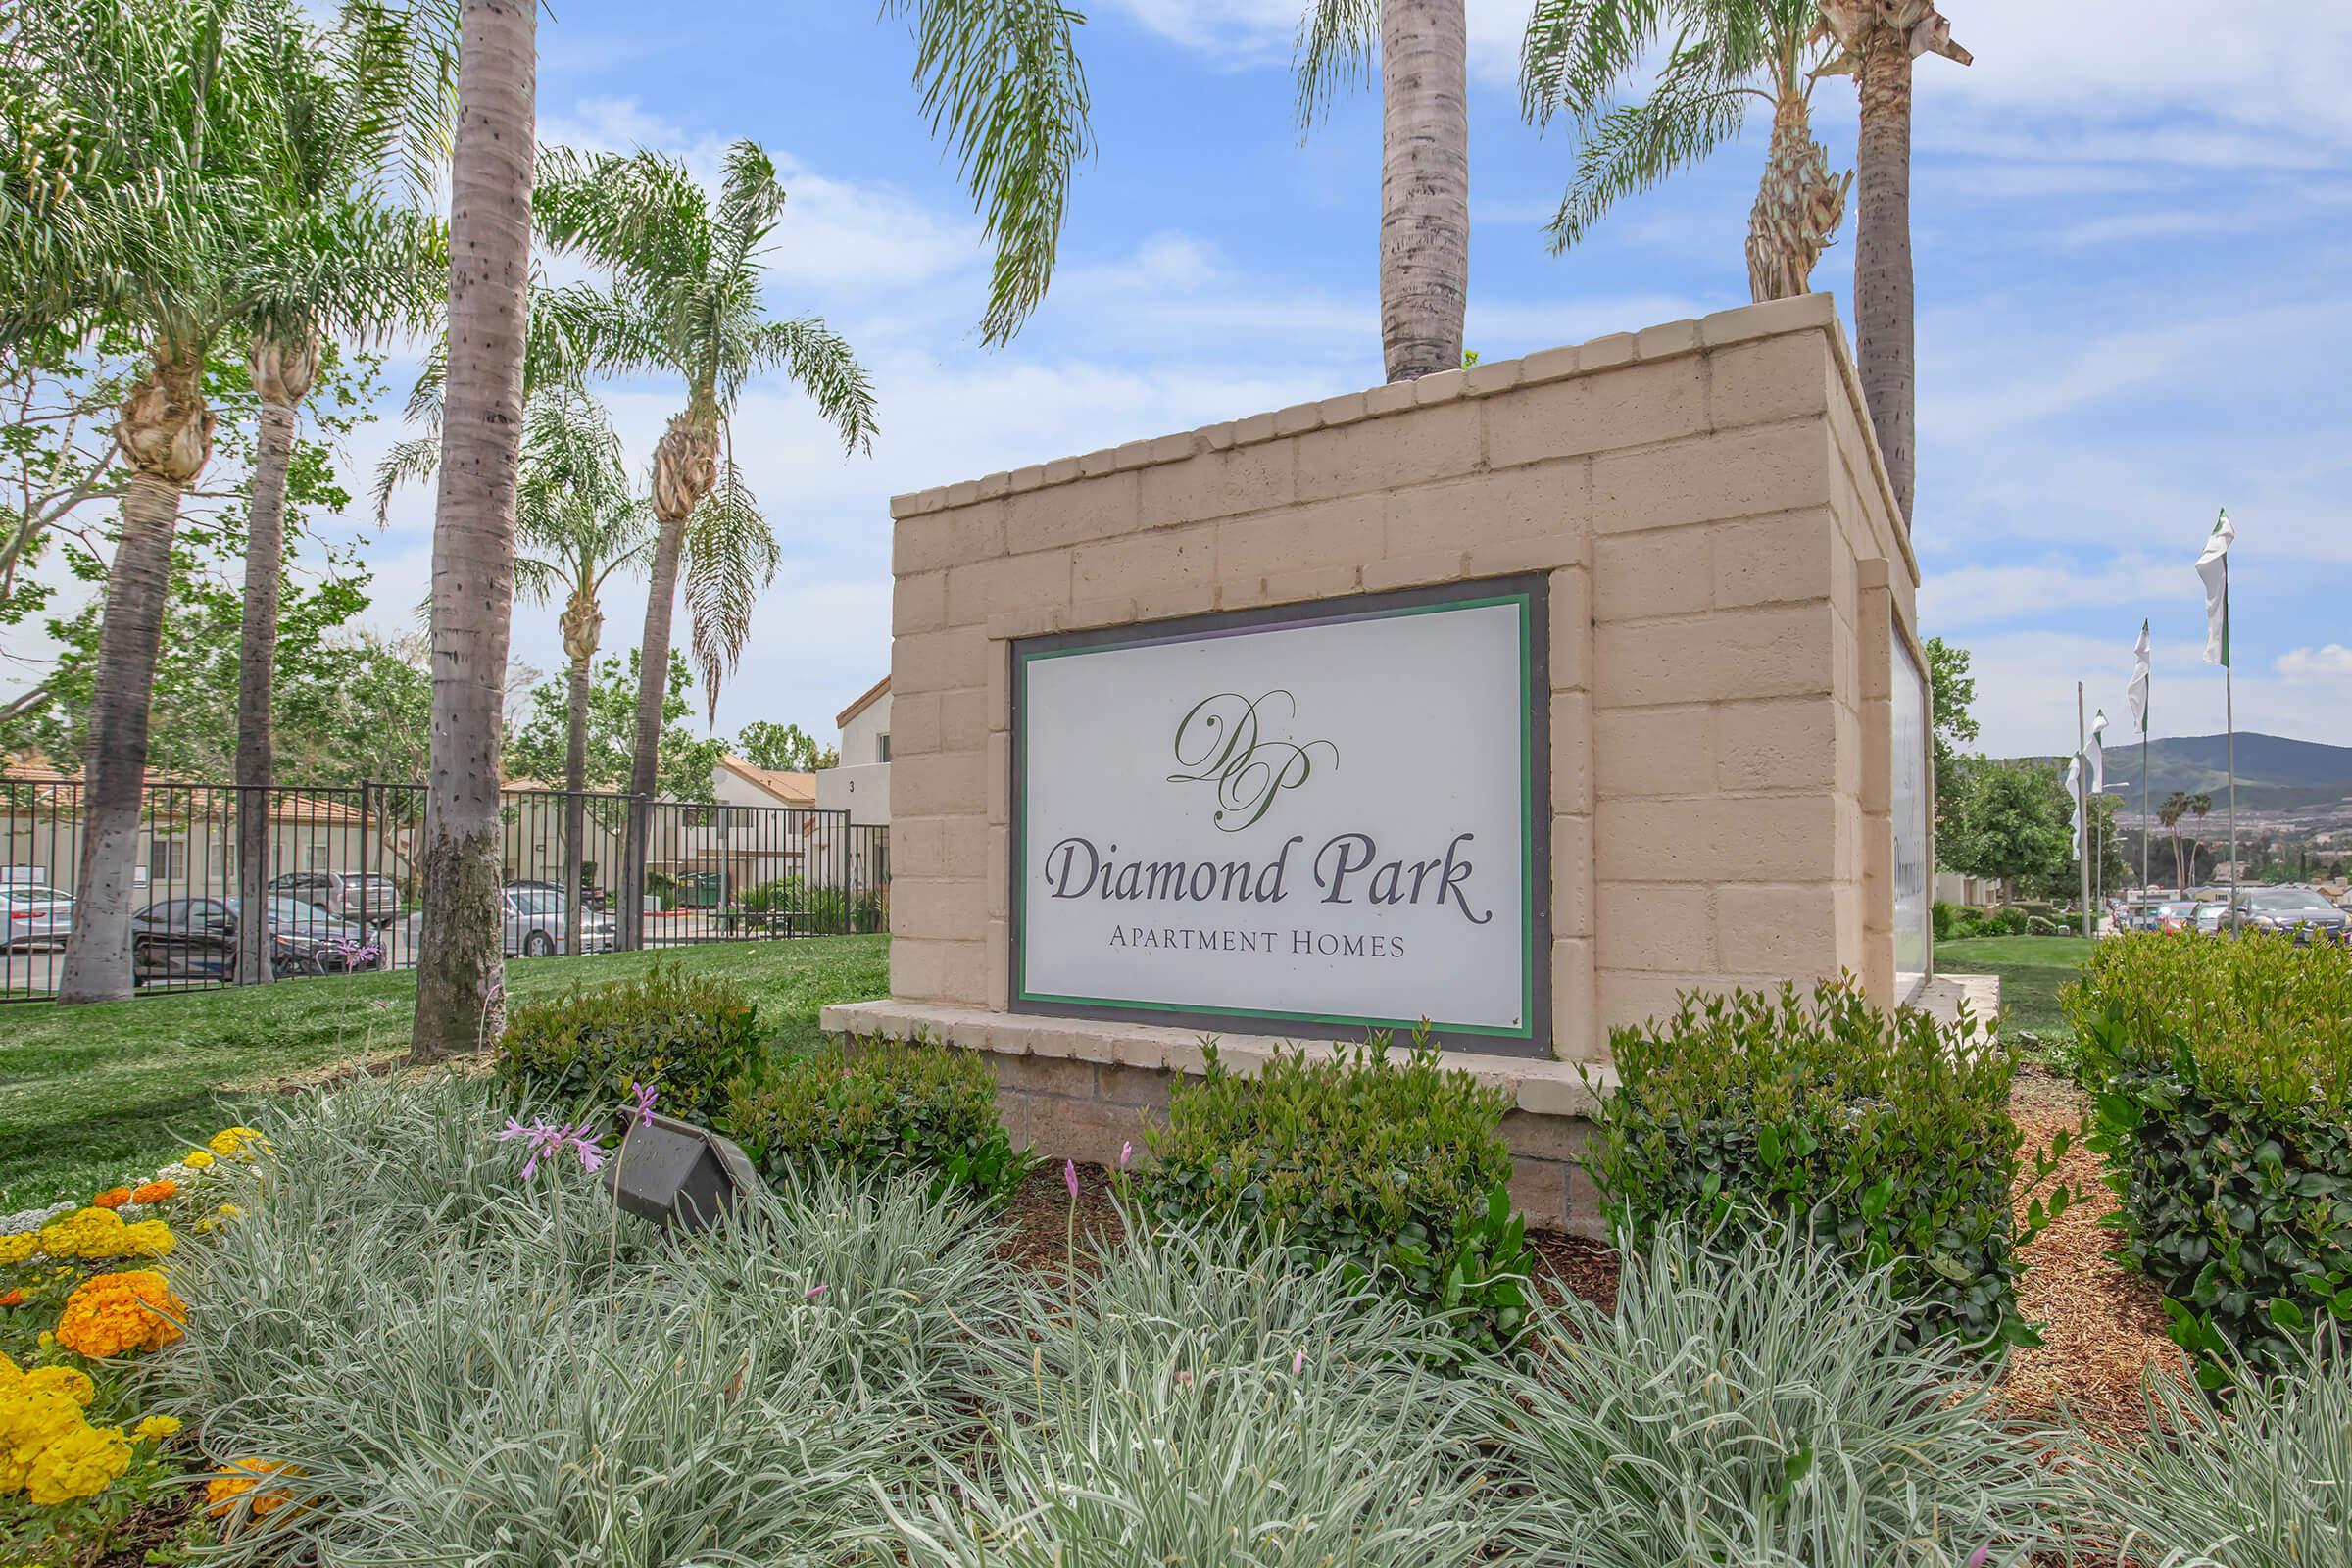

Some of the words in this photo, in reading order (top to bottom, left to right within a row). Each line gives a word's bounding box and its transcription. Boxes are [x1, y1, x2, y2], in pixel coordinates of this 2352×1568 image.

[849, 780, 855, 793] 3
[1045, 835, 1304, 903] Diamond
[1313, 833, 1493, 925] Park
[1108, 924, 1279, 953] APARTMENT
[1291, 929, 1405, 958] HOMES
